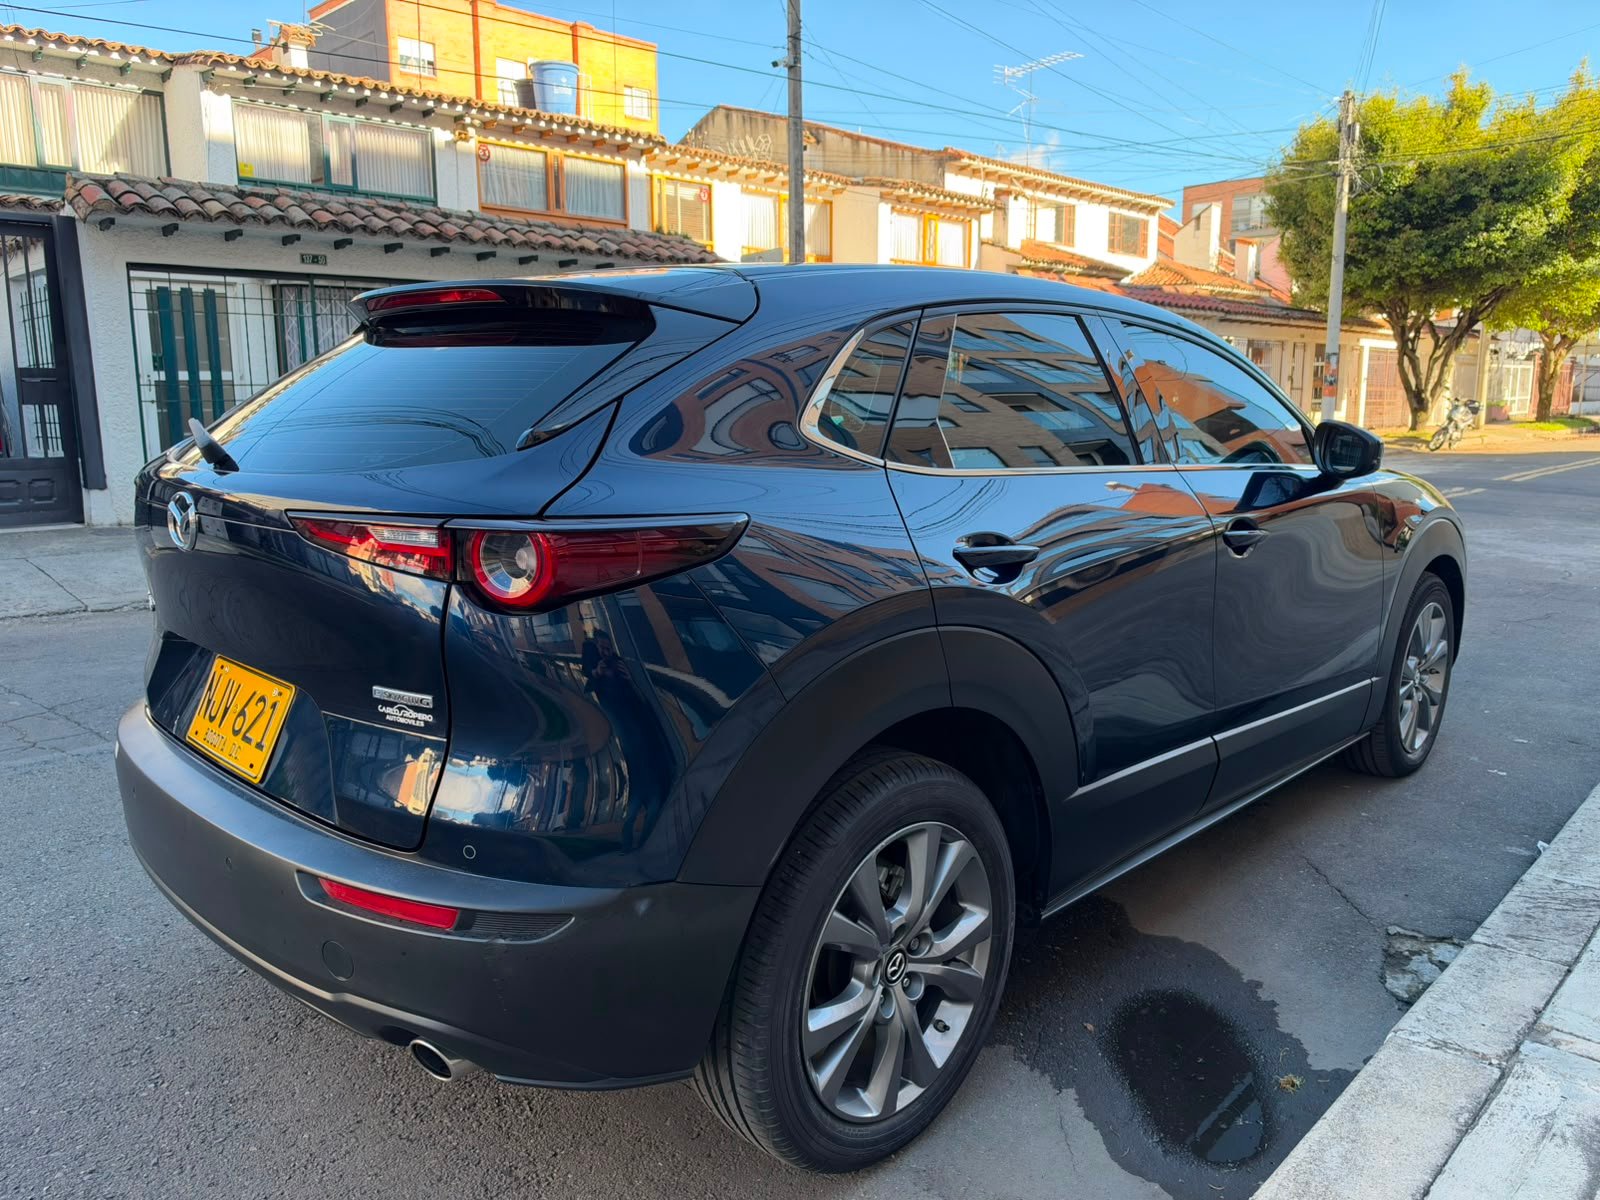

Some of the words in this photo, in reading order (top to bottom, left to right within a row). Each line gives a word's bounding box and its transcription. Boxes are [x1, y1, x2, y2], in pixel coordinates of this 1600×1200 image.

[198, 671, 242, 728] NJV
[232, 690, 279, 752] 621
[403, 710, 433, 721] ROPERO
[386, 714, 424, 726] AUTOMOVILES
